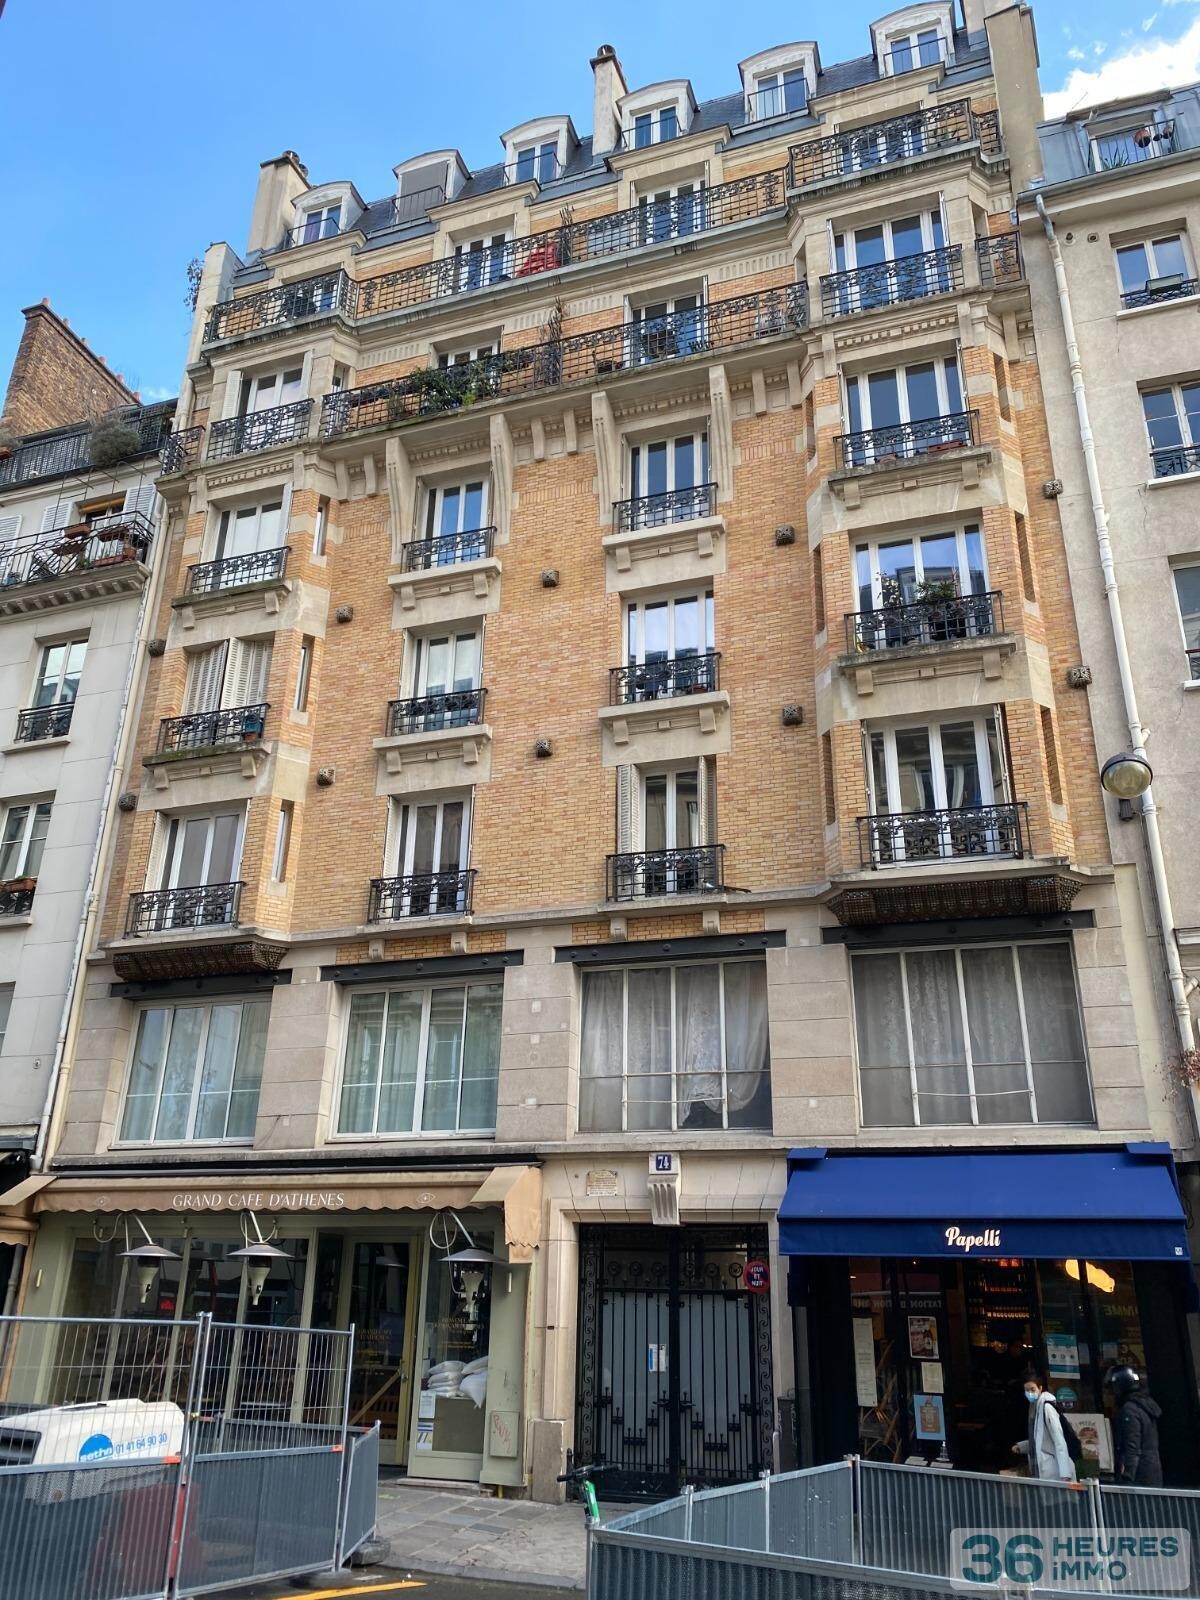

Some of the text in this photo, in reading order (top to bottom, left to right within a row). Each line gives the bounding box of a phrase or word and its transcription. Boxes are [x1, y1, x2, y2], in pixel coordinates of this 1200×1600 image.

[657, 1156, 669, 1169] 74
[172, 1192, 345, 1207] GRAND CAFE D'ATHENES
[945, 1226, 1001, 1252] Papelli
[115, 1443, 124, 1455] 01
